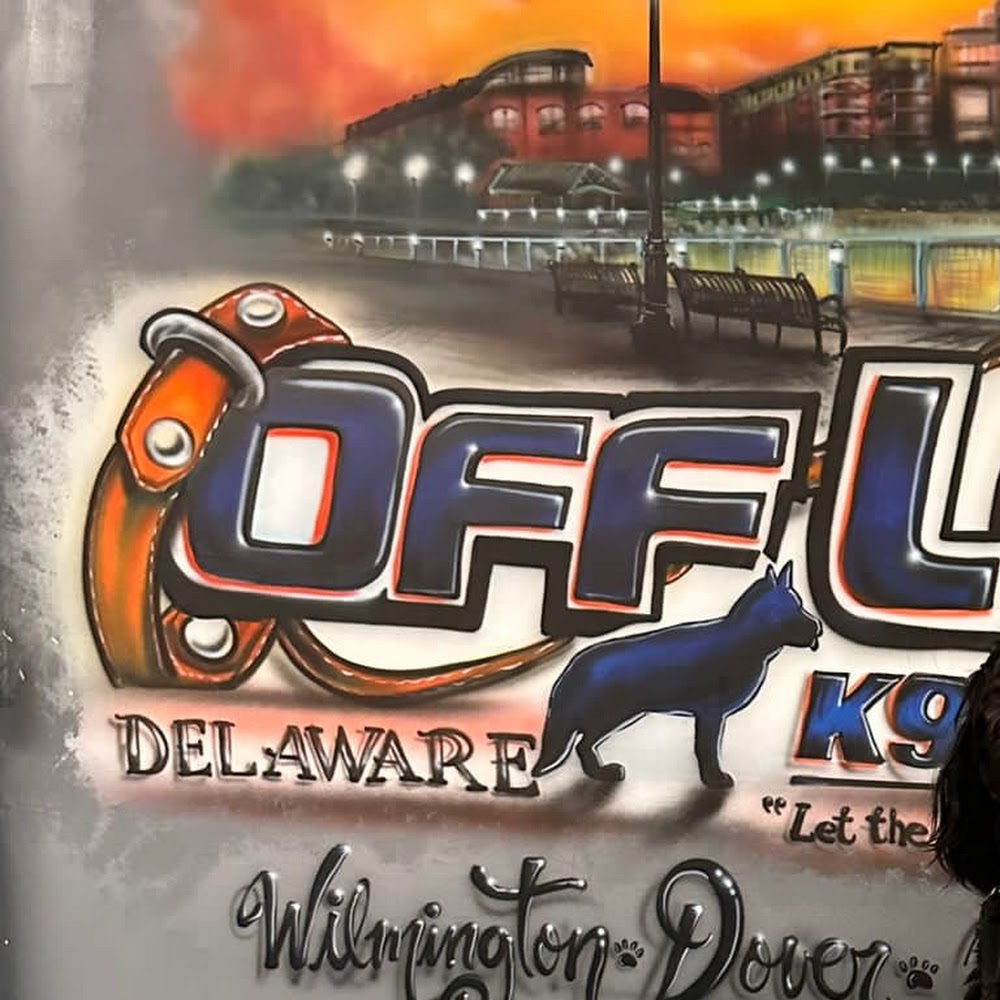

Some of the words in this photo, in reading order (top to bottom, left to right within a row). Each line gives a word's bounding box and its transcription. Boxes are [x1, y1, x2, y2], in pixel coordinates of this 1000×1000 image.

[181, 362, 790, 614] OFF
[114, 712, 541, 797] DELAWARE
[794, 670, 968, 770] K9
[865, 806, 932, 847] the
